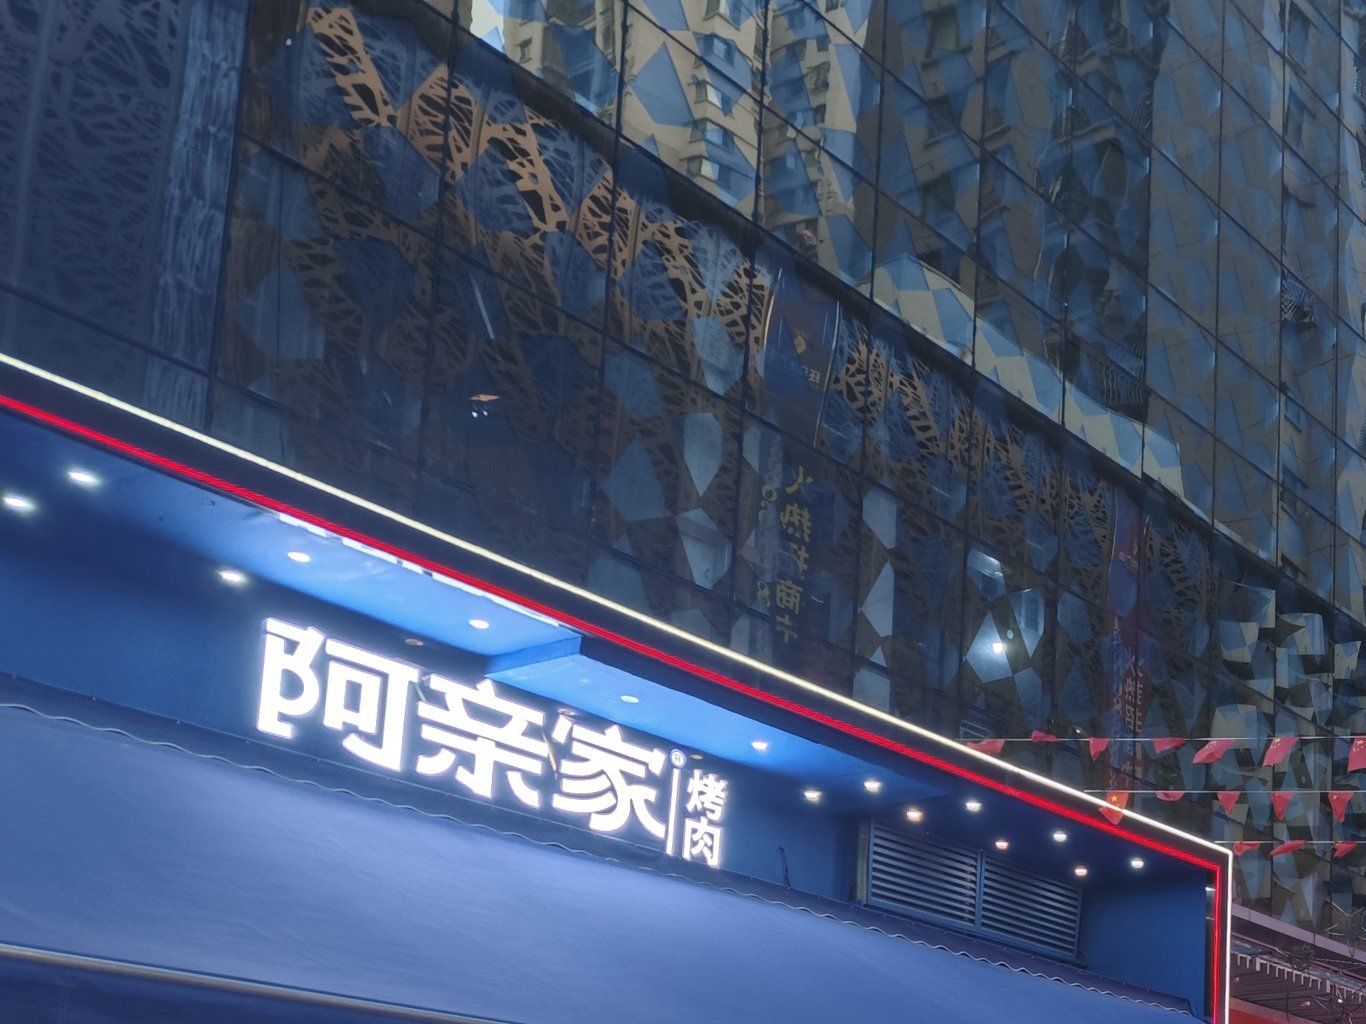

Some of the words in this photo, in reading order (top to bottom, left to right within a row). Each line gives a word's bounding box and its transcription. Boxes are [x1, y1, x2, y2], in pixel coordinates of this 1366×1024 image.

[257, 617, 669, 840] 阿亲家
[684, 769, 728, 867] 烤肉
